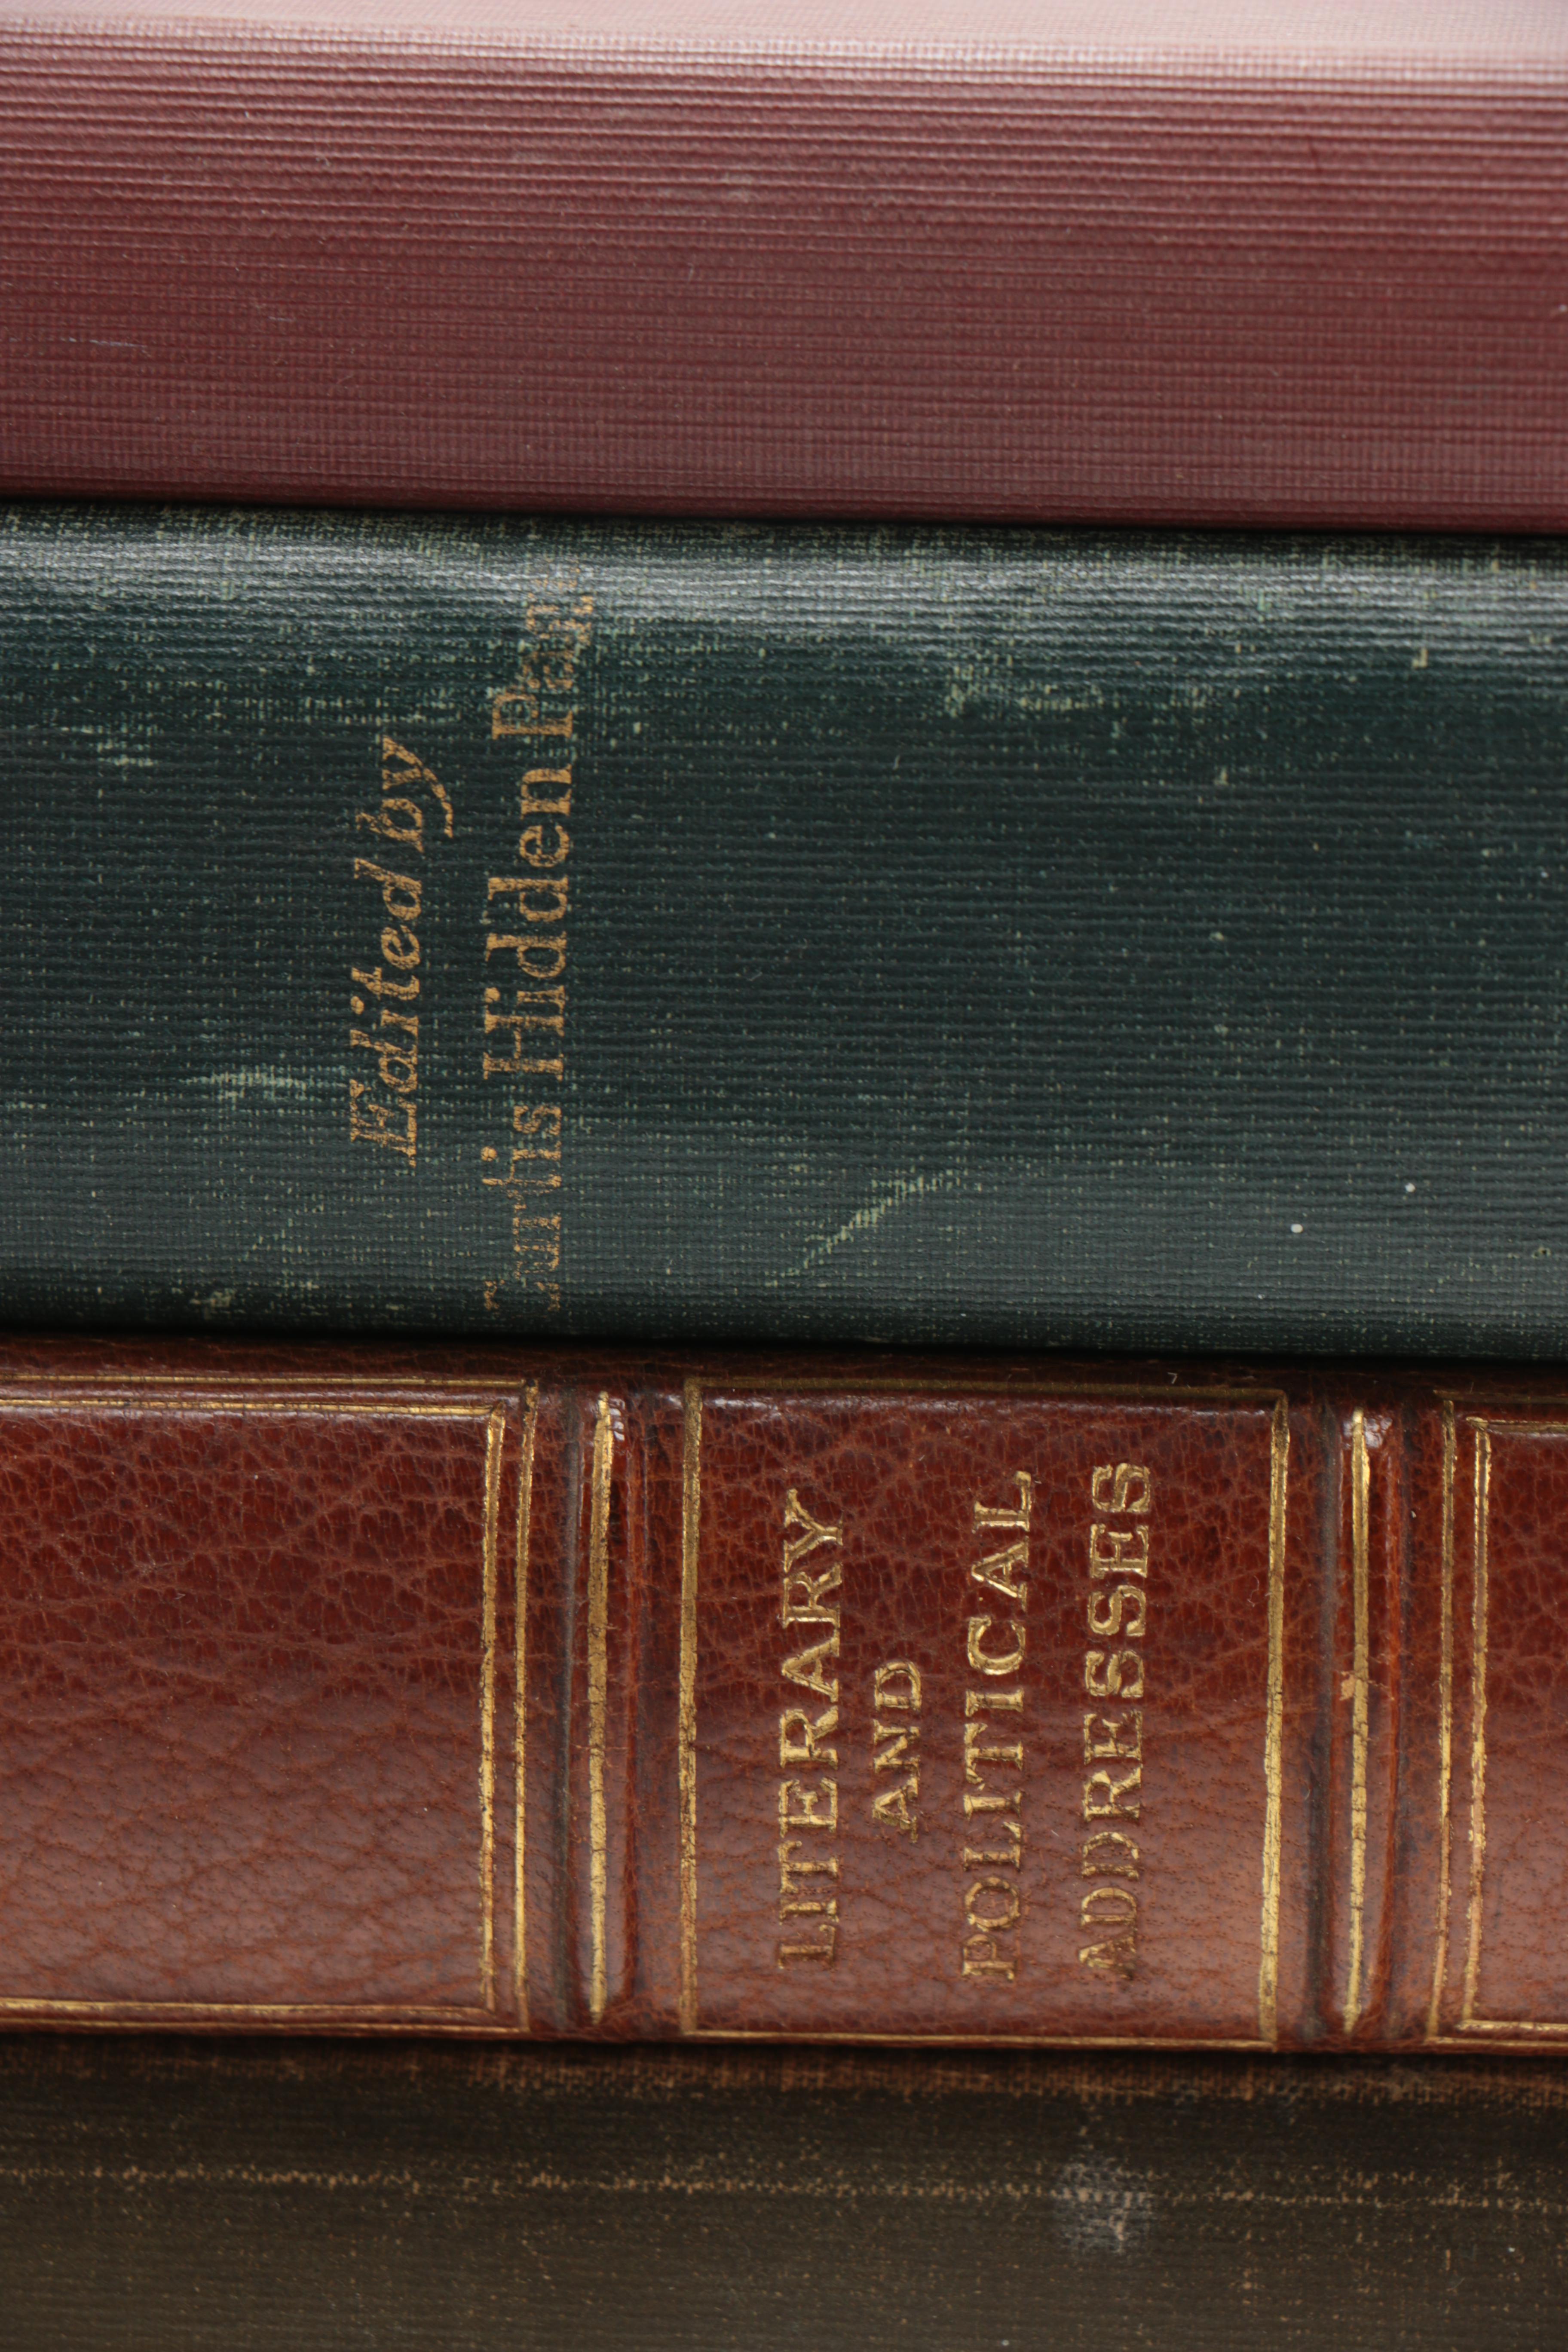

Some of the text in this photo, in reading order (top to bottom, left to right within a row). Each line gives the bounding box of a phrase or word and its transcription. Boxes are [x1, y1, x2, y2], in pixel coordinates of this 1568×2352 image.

[350, 735, 453, 1167] Edited by
[484, 763, 573, 1081] Hidden
[480, 1105, 562, 1319] Curtis
[778, 1488, 844, 1969] LITERARY
[872, 1660, 922, 1843] AND
[962, 1470, 1032, 1981] POLITICAL
[1078, 1462, 1151, 1979] ADDRESSES
